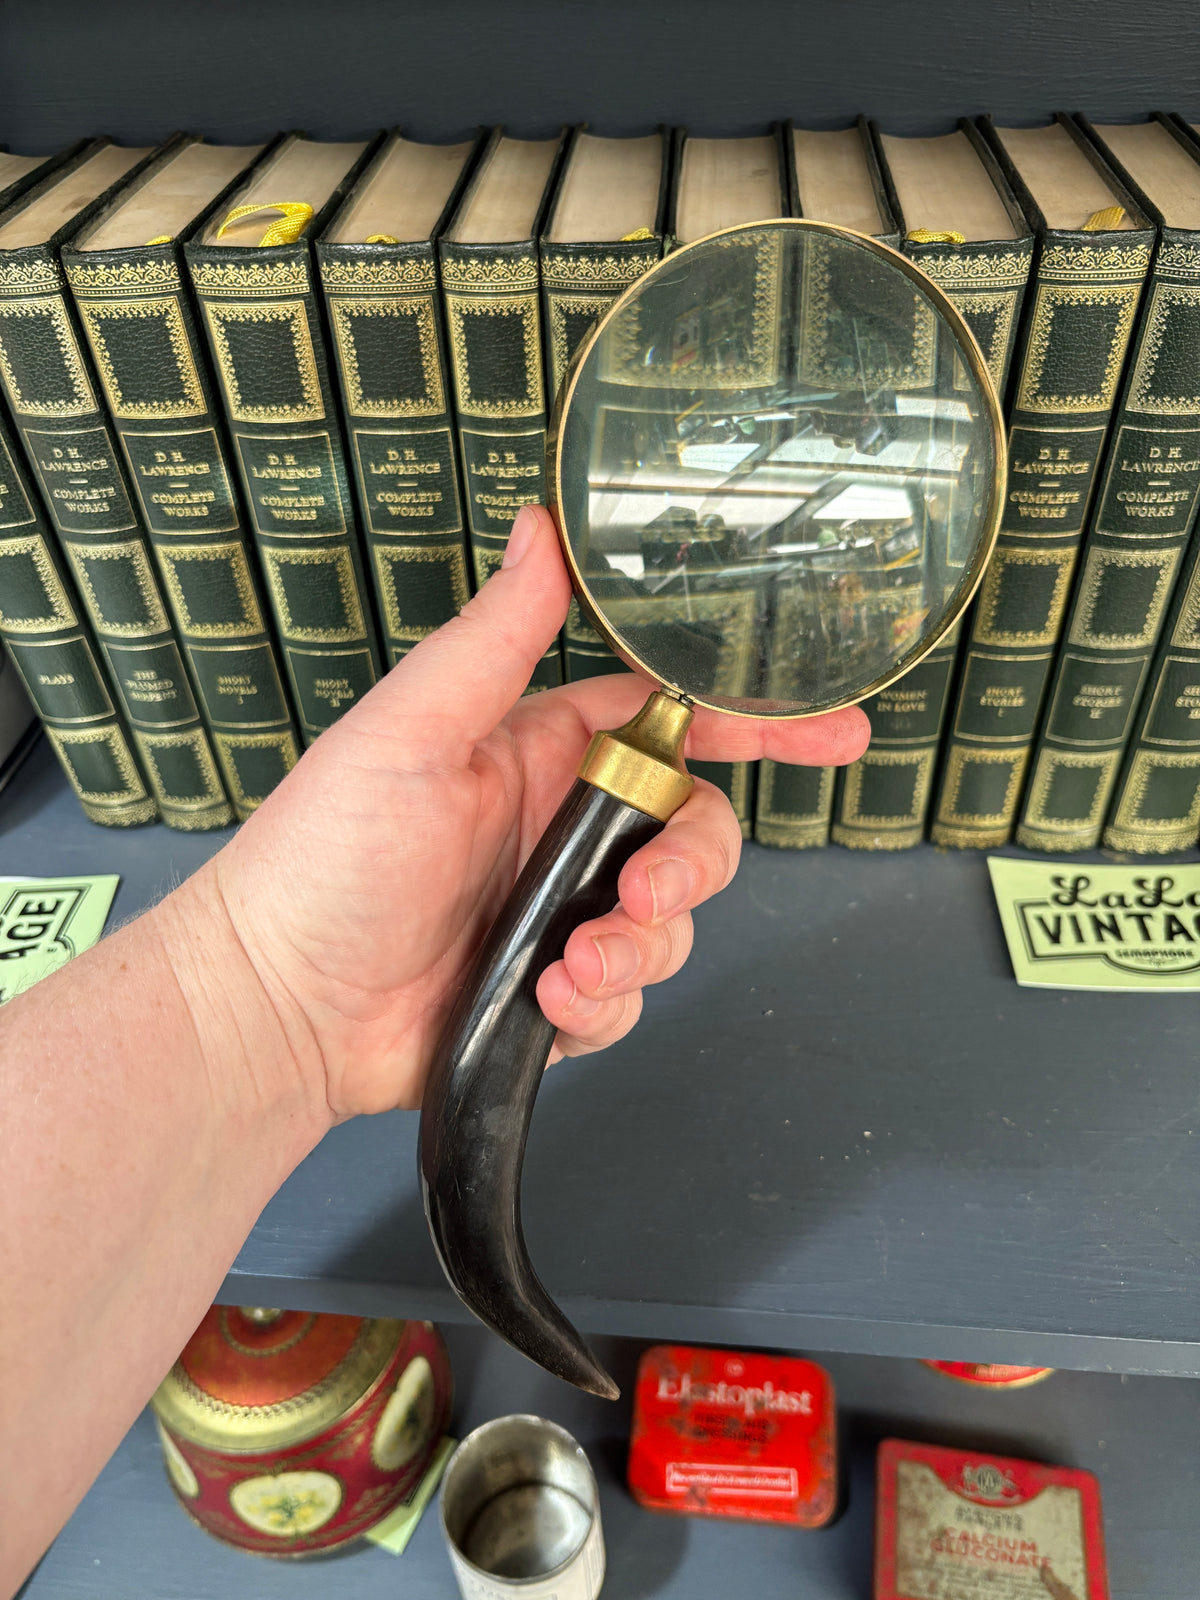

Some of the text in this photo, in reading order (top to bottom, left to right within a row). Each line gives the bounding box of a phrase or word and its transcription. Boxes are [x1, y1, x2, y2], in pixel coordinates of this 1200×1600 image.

[41, 458, 109, 473] LAWRENCE
[140, 462, 211, 477] LAWRENCE
[250, 465, 323, 480] LAWRENCE
[369, 461, 441, 476] LAWRENCE
[470, 463, 541, 478] LAWRENCE
[1013, 459, 1091, 475] LAWRENCE
[1121, 459, 1200, 474] LAWRENCE
[53, 485, 117, 501] COMPLETE
[151, 489, 217, 504] COMPLETE
[376, 491, 443, 504] COMPLETE
[475, 493, 541, 507] COMPLETE
[1009, 490, 1081, 504] COMPLETE
[1116, 490, 1190, 504] COMPLETE
[65, 501, 110, 514] WORKS
[260, 494, 326, 508] COMPLETE
[162, 504, 209, 518] WORKS
[271, 508, 318, 521] WORKS
[387, 505, 435, 517] WORKS
[484, 507, 520, 521] WOR
[1018, 505, 1068, 519] WORKS
[1124, 504, 1176, 518] WORKS
[876, 701, 927, 713] IN LOVE
[944, 1527, 1037, 1554] CALCIUM
[930, 1537, 1051, 1569] GLUCONATE
